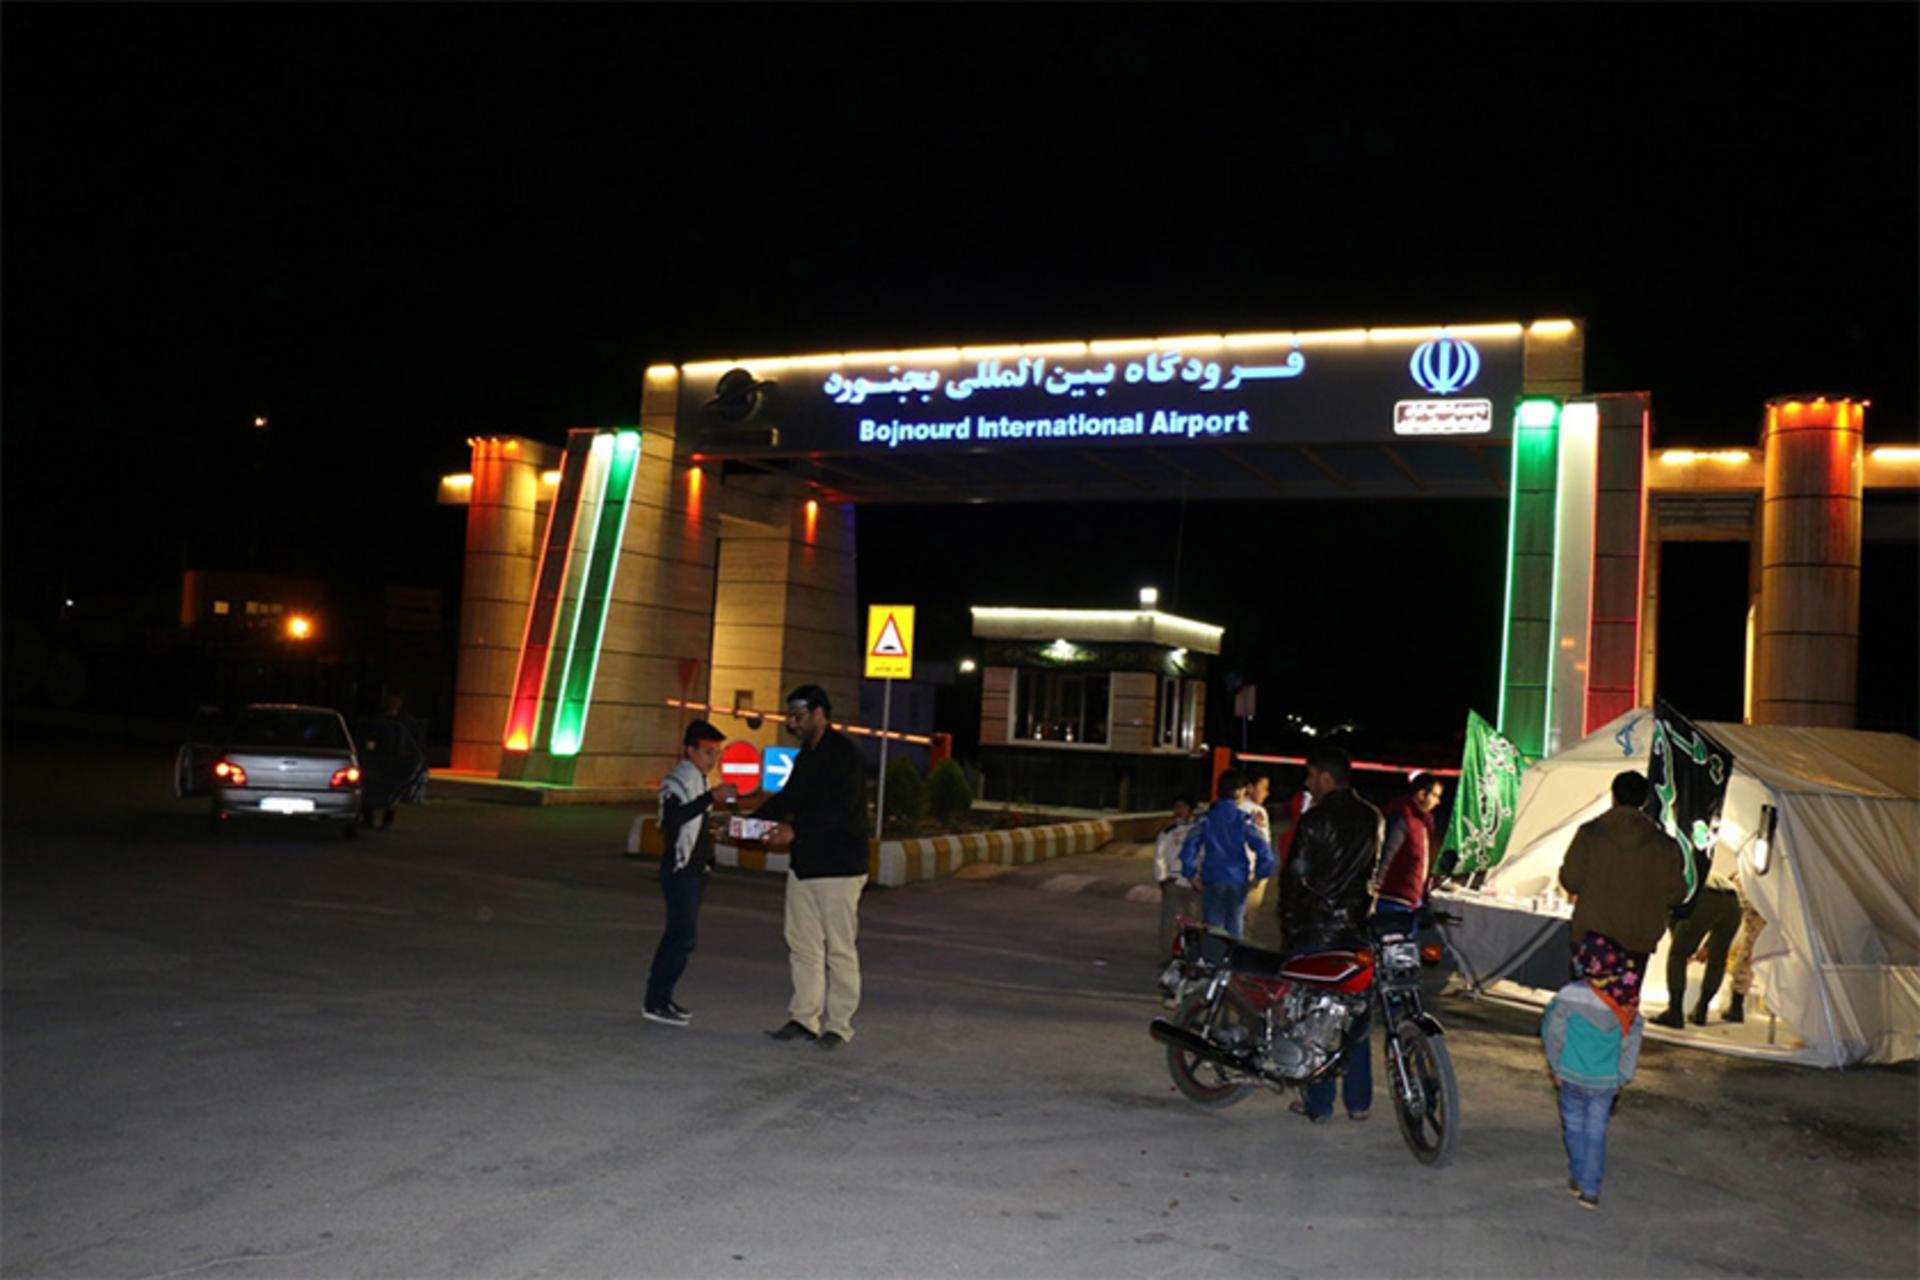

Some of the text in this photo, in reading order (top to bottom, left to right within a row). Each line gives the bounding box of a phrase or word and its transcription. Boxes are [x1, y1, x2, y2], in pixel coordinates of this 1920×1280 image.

[823, 365, 940, 404] بجنورد
[1124, 340, 1305, 390] فرودگاه
[859, 410, 1250, 447] Bojnourd International Airport
